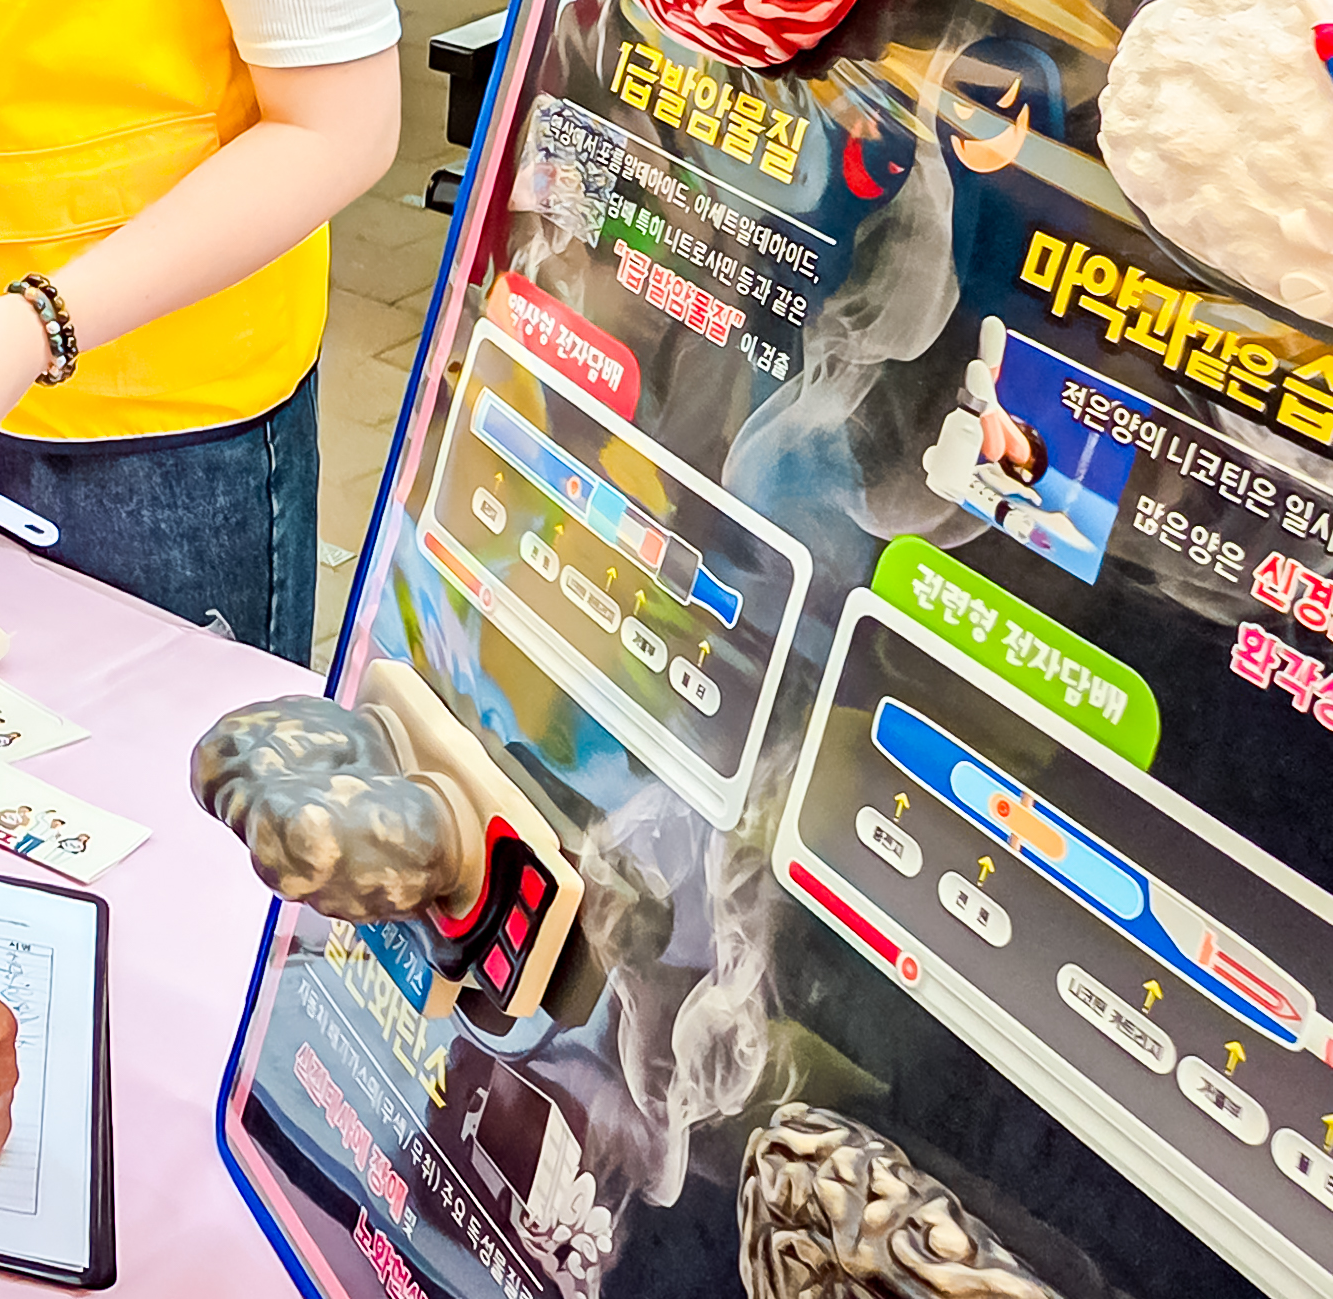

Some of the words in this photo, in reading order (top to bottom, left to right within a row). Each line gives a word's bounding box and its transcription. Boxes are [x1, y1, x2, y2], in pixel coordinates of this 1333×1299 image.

[610, 41, 811, 185] 1급발암물질
[663, 223, 737, 288] 니트로사민
[771, 286, 809, 328] 같은
[693, 192, 822, 285] 아세트알데하이드,
[506, 292, 555, 347] 액상형
[555, 324, 625, 392] 전자담배
[1060, 380, 1169, 460] 적은양의
[1168, 435, 1278, 520] 니코틴은
[1132, 494, 1247, 583] 많은양은
[1000, 619, 1129, 726] 전자담배
